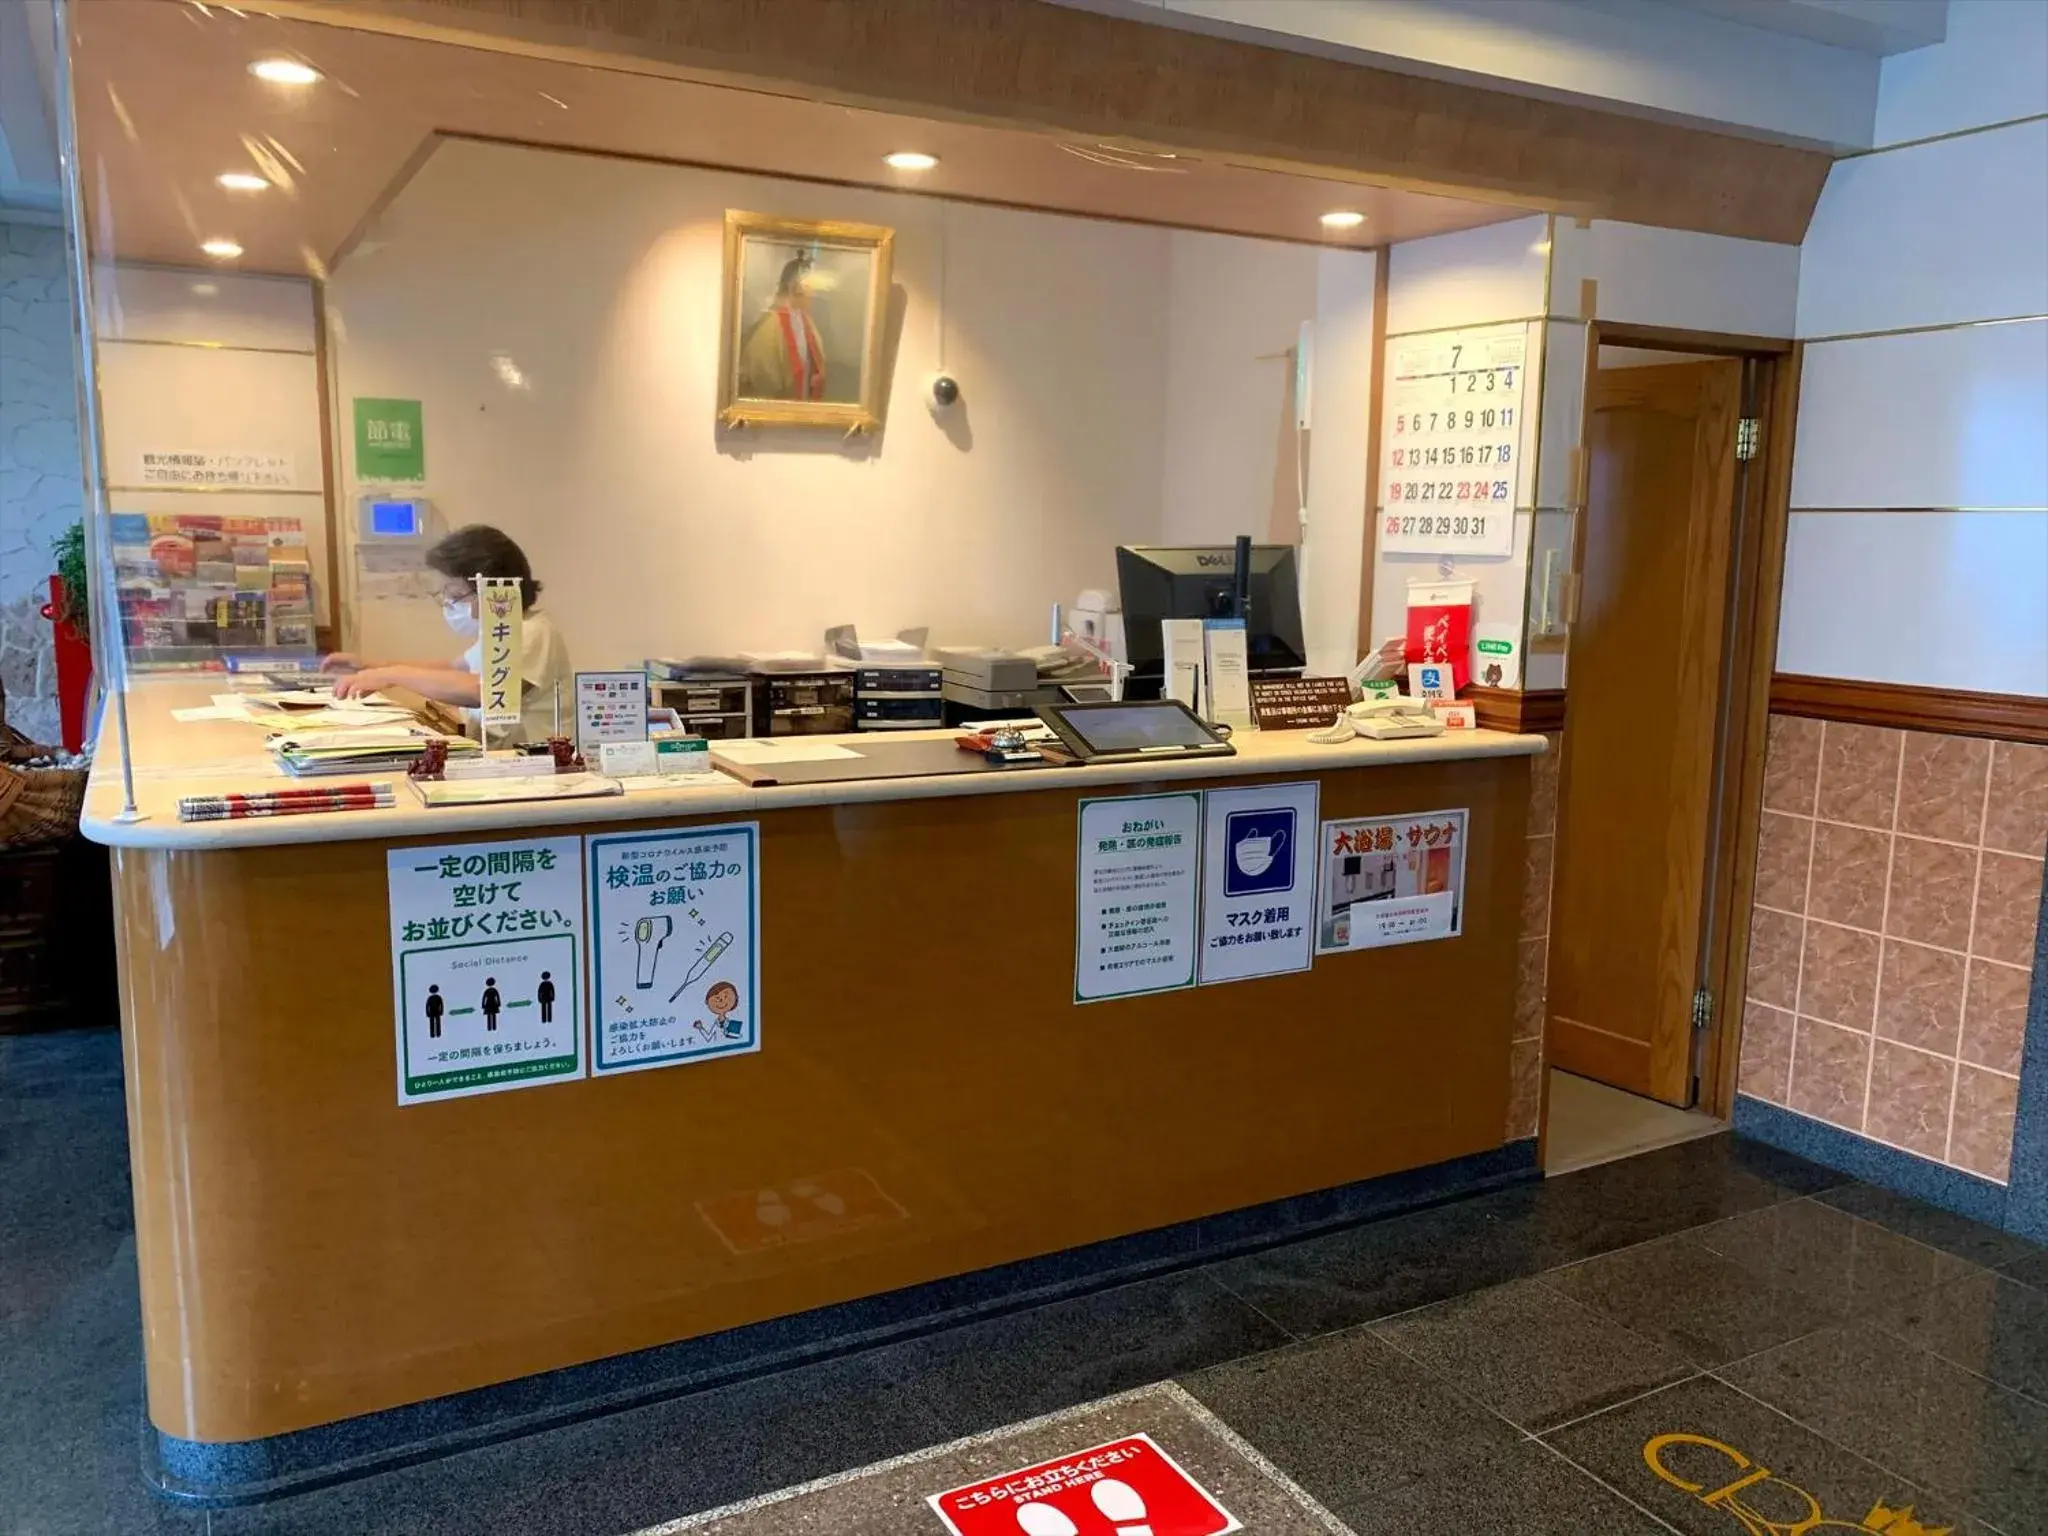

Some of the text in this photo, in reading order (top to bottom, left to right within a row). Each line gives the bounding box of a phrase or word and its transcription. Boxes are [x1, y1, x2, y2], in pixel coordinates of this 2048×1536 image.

[1452, 345, 1463, 369] 7
[1450, 371, 1513, 394] 1 2 3 4
[1397, 408, 1513, 432] 5 6 7 8 9 10 11
[1392, 444, 1511, 466] 12 13 14 15 16 17 18
[1390, 481, 1508, 500] 19 20 21 22 23 24 25
[1386, 516, 1486, 535] 26 27 28 29 30 31
[489, 622, 511, 711] キングス
[1122, 819, 1164, 833] おねがい
[414, 848, 557, 879] 一定の間隔を
[606, 861, 741, 889] 検温のご協力の
[452, 881, 522, 908] 空けて
[649, 886, 704, 906] お願い
[402, 908, 573, 943] お並びください。
[1226, 907, 1290, 926] マスク着用
[1209, 927, 1303, 949] ご協力をお願い致します
[451, 953, 529, 970] Social Distance
[608, 1016, 677, 1033] 感染拡大防止の
[609, 1031, 647, 1044] ご協力を
[426, 1038, 557, 1062] 一定の間隔を保ちましょう。
[955, 1445, 1142, 1511] こちらにお立ちください
[1013, 1469, 1106, 1504] STAND HERE
